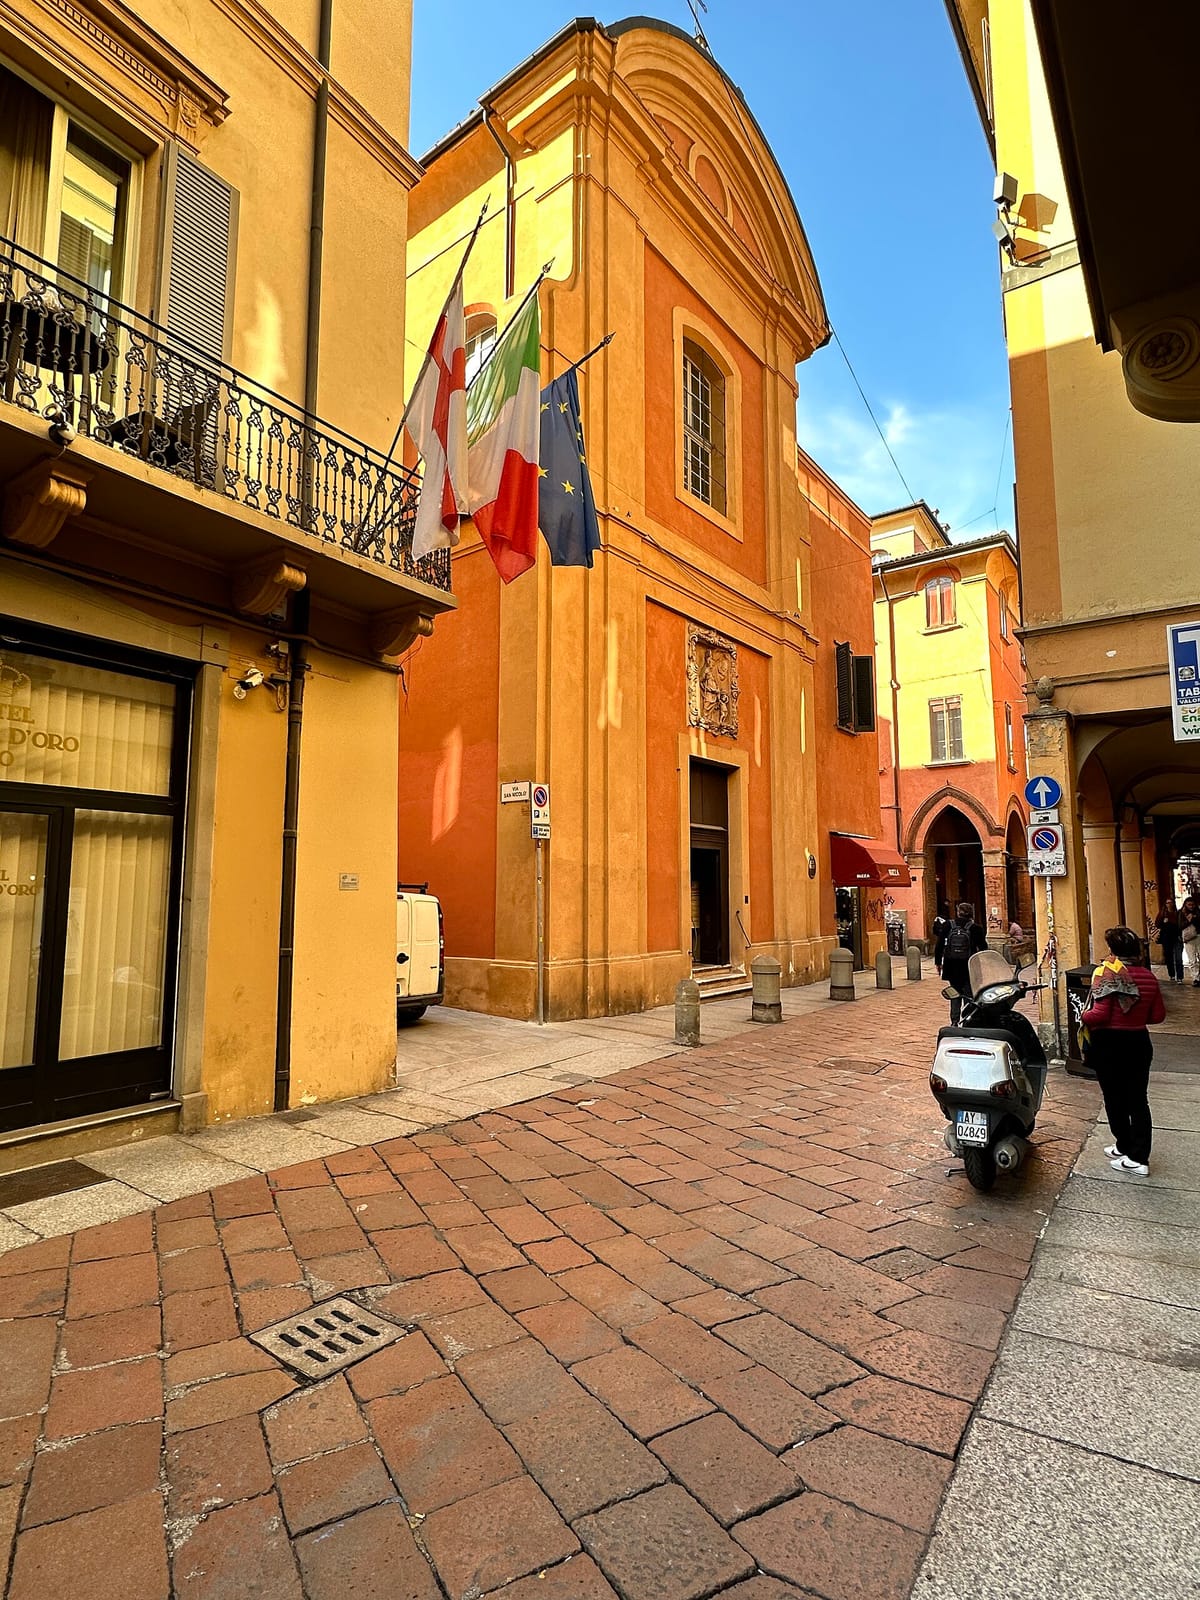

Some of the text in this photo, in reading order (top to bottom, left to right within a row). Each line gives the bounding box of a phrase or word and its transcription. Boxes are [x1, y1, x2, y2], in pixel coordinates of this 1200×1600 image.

[1179, 687, 1200, 697] TAB
[9, 727, 79, 753] D'ORO
[965, 1112, 976, 1124] AY
[957, 1125, 986, 1139] 04849
